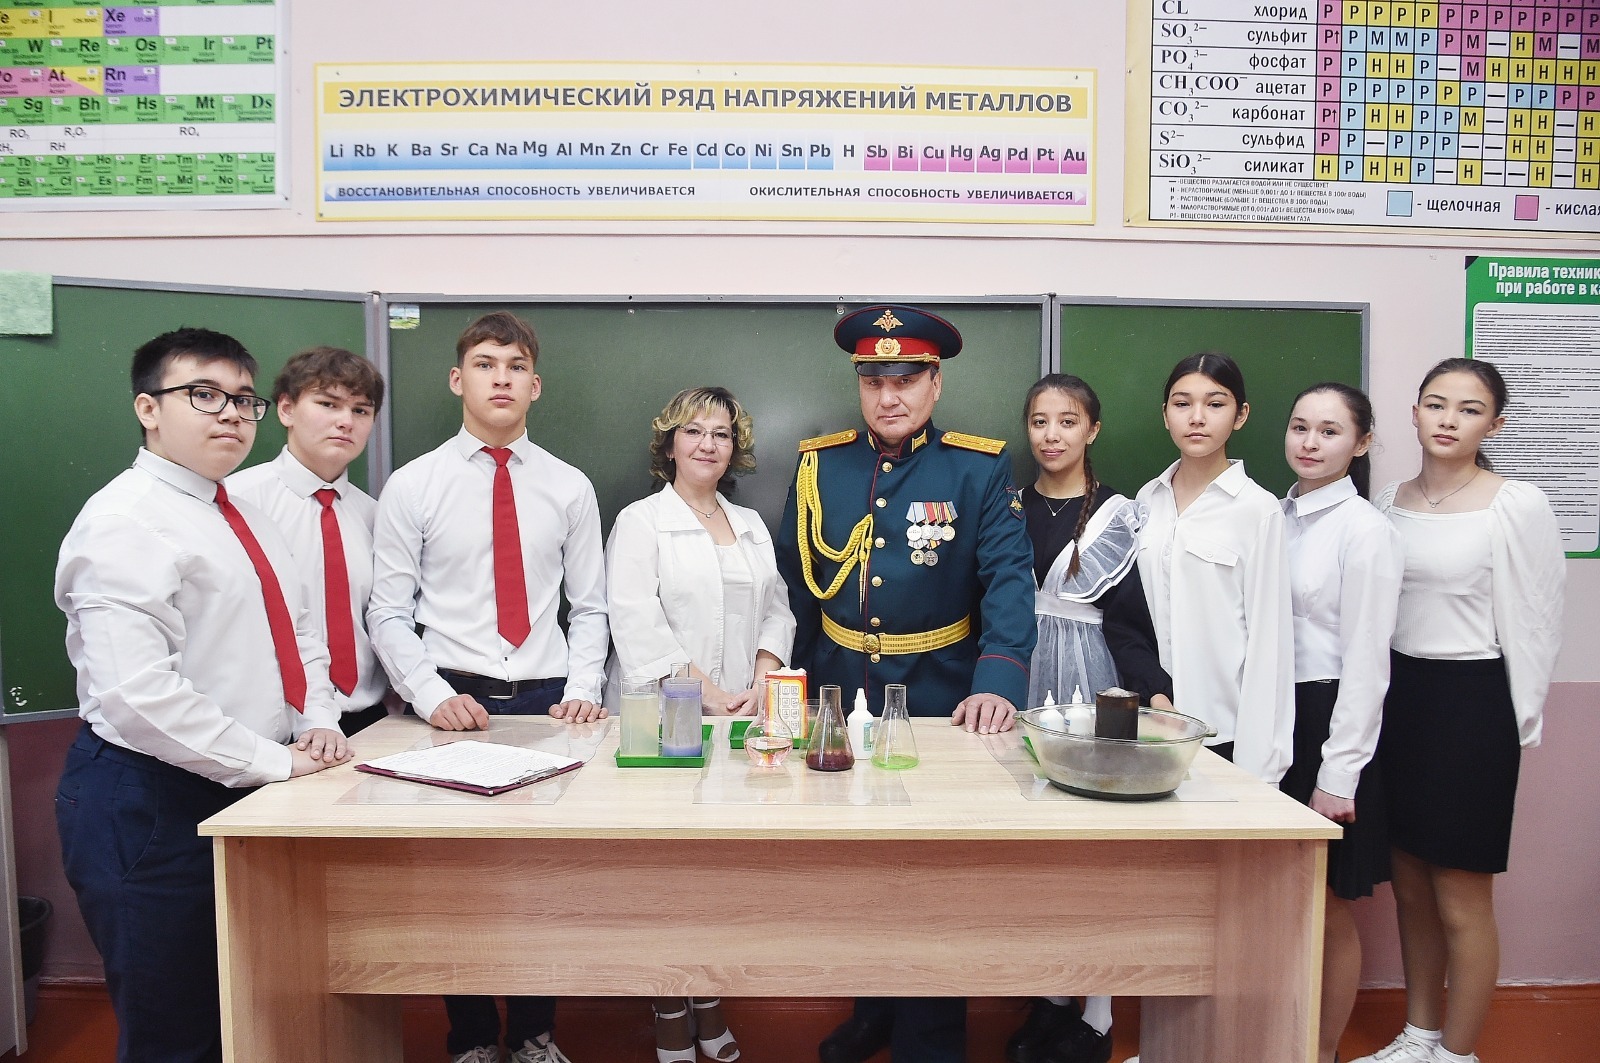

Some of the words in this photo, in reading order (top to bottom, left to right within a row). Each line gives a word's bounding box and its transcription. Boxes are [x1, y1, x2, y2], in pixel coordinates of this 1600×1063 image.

[0, 11, 10, 23] e
[106, 9, 125, 22] Xe
[1254, 6, 1307, 20] хлорид
[1324, 4, 1333, 18] Р
[1351, 6, 1358, 19] Р
[1375, 6, 1382, 20] Р
[1398, 8, 1406, 21] Р
[1422, 9, 1430, 22] Р
[1447, 9, 1455, 22] Р
[1470, 10, 1479, 24] Р
[28, 40, 43, 52] W
[80, 39, 100, 52] Re
[136, 38, 156, 51] Os
[204, 37, 214, 50] Ir
[256, 37, 272, 49] Pt
[1248, 29, 1307, 45] сульфит
[1350, 30, 1358, 44] Р
[1372, 31, 1383, 45] М
[1396, 32, 1408, 46] М
[1422, 33, 1430, 46] Р
[1445, 34, 1453, 48] Р
[1467, 35, 1479, 49] М
[1516, 37, 1525, 50] Н
[1250, 53, 1306, 70] фосфат
[1324, 57, 1332, 71] Р
[1349, 58, 1357, 71] Р
[1373, 59, 1381, 72] Н
[1396, 59, 1404, 73] Н
[1421, 60, 1429, 74] Р
[0, 70, 12, 82] o
[48, 69, 65, 81] At
[106, 68, 126, 80] Rn
[1256, 83, 1306, 95] ацетат
[24, 99, 43, 112] Sg
[80, 98, 100, 110] Bh
[137, 97, 156, 110] Hs
[196, 96, 214, 109] Mt
[252, 96, 272, 108] Ds
[340, 83, 650, 107] ЭЛЕКТРОХИМИЧЕСКИЙ
[662, 89, 714, 110] РЯД
[725, 86, 915, 109] НАПРЯЖЕНИЙ
[926, 92, 1071, 112] МЕТАЛЛОВ
[1233, 105, 1305, 122] карбонат
[50, 142, 65, 151] RH
[1243, 132, 1304, 149] сульфид
[1322, 133, 1330, 146] Р
[1348, 134, 1356, 147] Р
[97, 155, 111, 164] Ho
[331, 144, 343, 157] Li
[355, 144, 375, 157] Rb
[388, 144, 398, 156] K
[412, 144, 431, 156] Ba
[441, 144, 458, 156] Sr
[469, 143, 488, 156] Ca
[496, 143, 517, 155] Na
[524, 142, 547, 157] Mg
[557, 143, 571, 155] Al
[581, 143, 604, 155] Mn
[611, 143, 631, 155] Zn
[641, 143, 658, 155] Cr
[669, 143, 687, 155] Fe
[697, 143, 717, 156] Cd
[725, 144, 745, 156] Co
[756, 144, 771, 156] Ni
[782, 144, 802, 156] Sn
[811, 144, 830, 157] Pb
[844, 145, 854, 157] H
[867, 145, 887, 158] Sb
[898, 146, 912, 158] Bi
[924, 146, 944, 159] Cu
[951, 145, 972, 161] Hg
[980, 146, 1000, 161] Ag
[1008, 148, 1027, 160] Pd
[1038, 148, 1054, 161] Pt
[1064, 149, 1084, 161] Au
[1245, 161, 1304, 172] силикат
[1322, 160, 1330, 173] Н
[1346, 161, 1354, 174] Р
[1370, 162, 1379, 175] Н
[1394, 162, 1403, 176] Н
[1418, 163, 1426, 176] Р
[219, 176, 233, 184] No
[339, 187, 479, 197] ВОССТАНОВИТЕЛЬНАЯ
[488, 187, 580, 195] СПОСОБНОСТЬ
[588, 187, 694, 195] УВЕЛИЧИВАЕТСЯ
[750, 187, 860, 196] ОКИСЛИТЕЛЬНАЯ
[868, 188, 959, 198] СПОСОБНОСТЬ
[968, 190, 1072, 200] УВЕЛИЧИВАЕТСЯ
[1428, 200, 1500, 212] щелочная
[1489, 262, 1549, 280] Правила
[1496, 282, 1521, 296] при
[1526, 280, 1575, 297] работе
[1579, 283, 1586, 295] в
